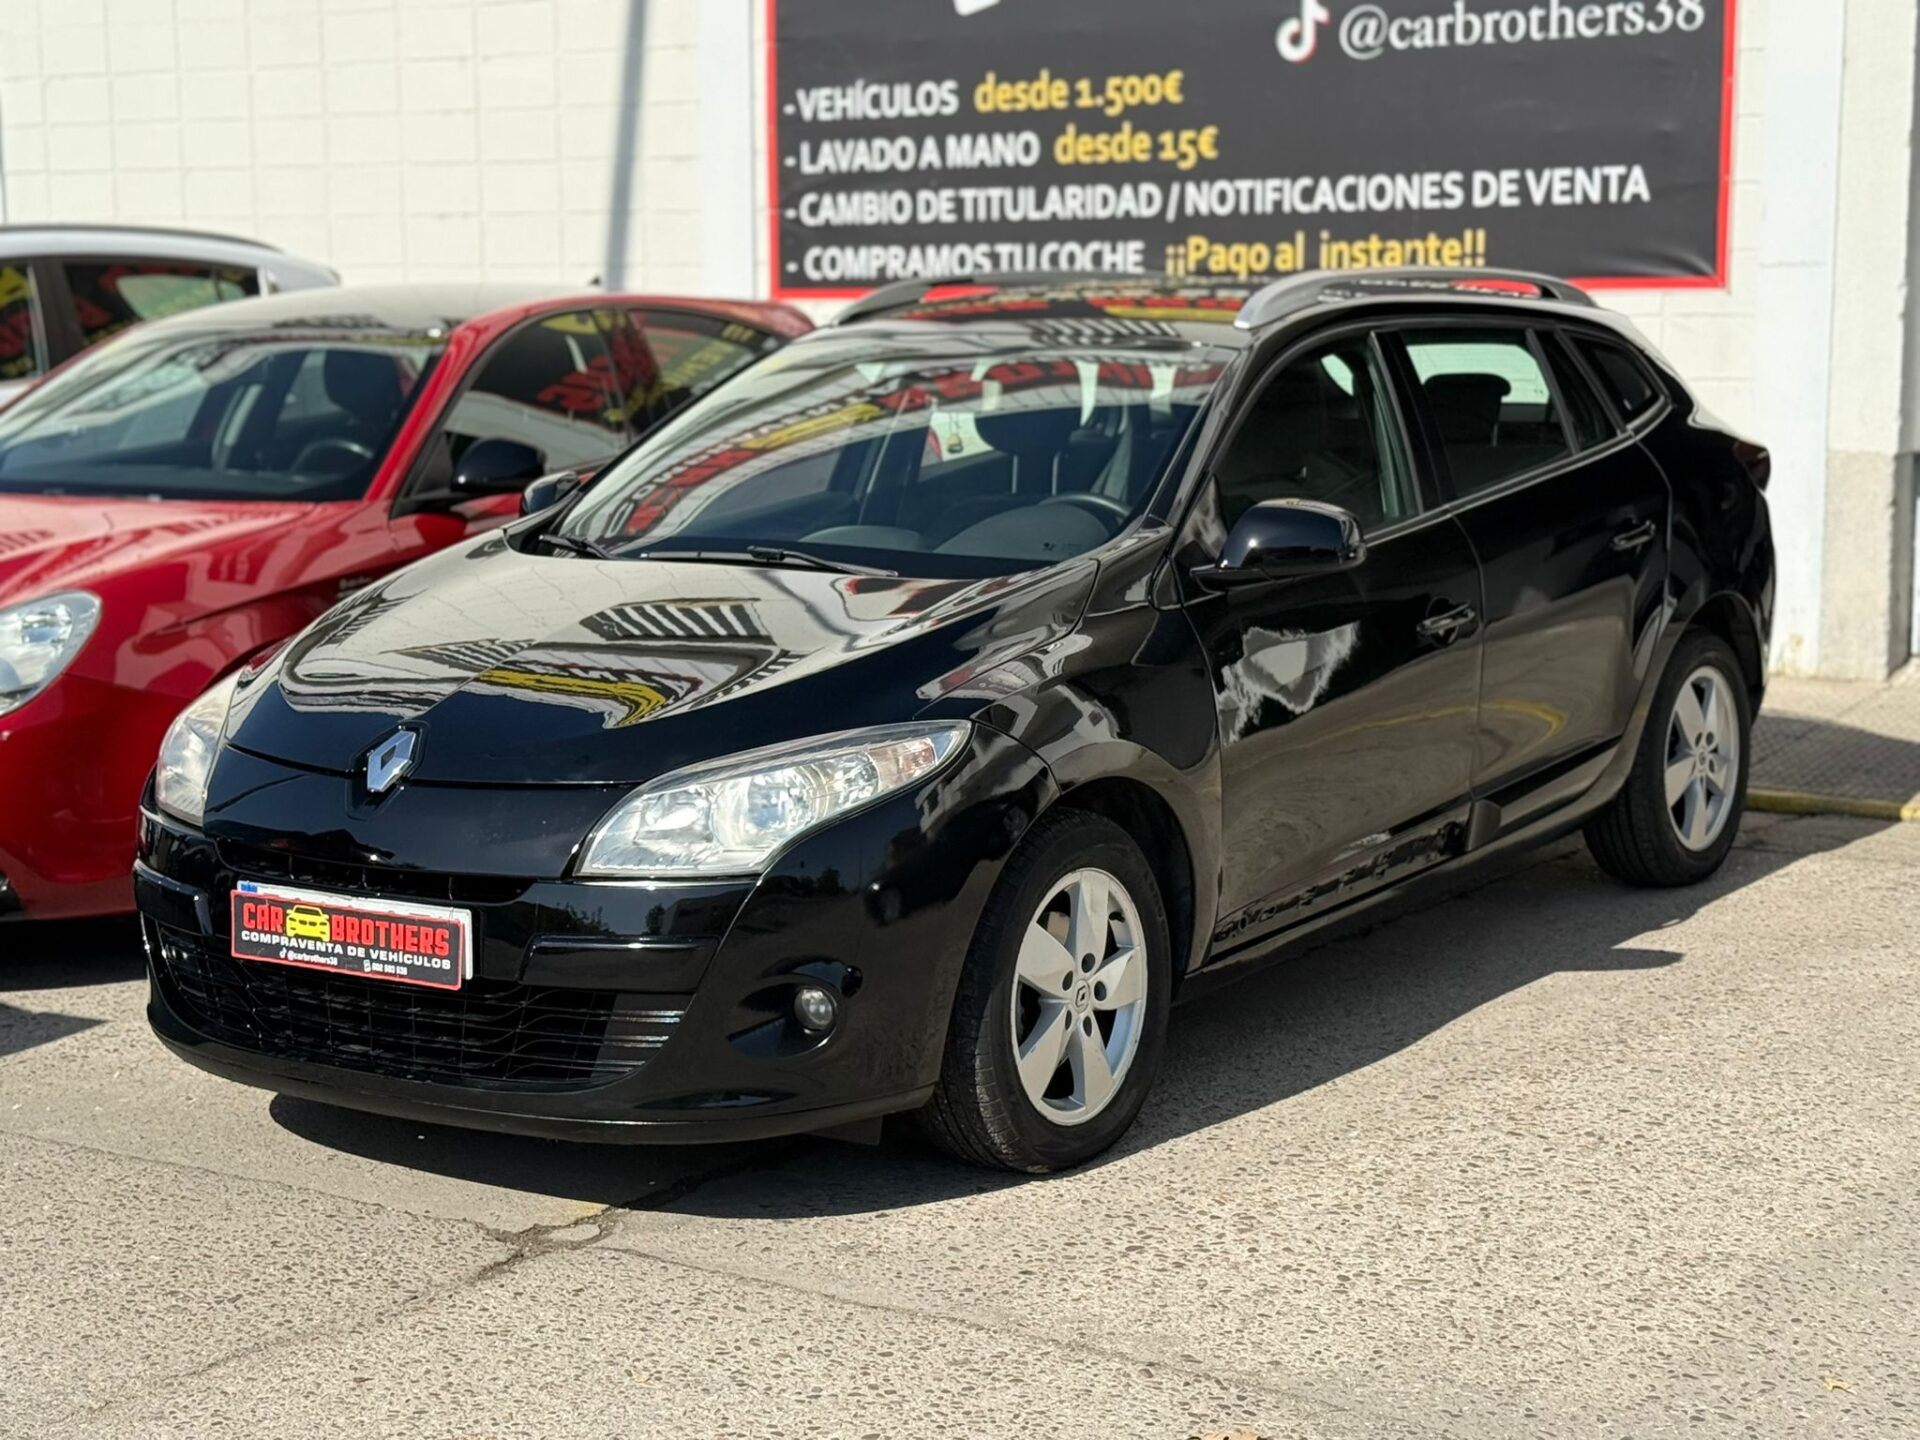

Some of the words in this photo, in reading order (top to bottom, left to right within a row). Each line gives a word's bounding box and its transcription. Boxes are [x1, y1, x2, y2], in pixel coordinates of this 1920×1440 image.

[1338, 0, 1706, 61] @carbrothers38
[796, 79, 959, 122] VEHÍCULOS
[974, 69, 1069, 113] desde
[1075, 70, 1184, 117] 1.500€
[800, 137, 916, 175] LAVADO
[918, 136, 942, 170] A
[945, 132, 1041, 168] MANO
[1054, 122, 1152, 165] desde
[1157, 126, 1219, 170] 15€
[800, 189, 913, 227] CAMBIO
[916, 188, 957, 224] DE
[959, 182, 1162, 222] TITULARIDAD
[1184, 171, 1464, 216] NOTIFICACIONES
[1472, 169, 1521, 209] DE
[1524, 164, 1652, 205] VENTA
[803, 242, 992, 281] COMPRAMOS
[1040, 239, 1146, 275] COCHE
[1274, 229, 1306, 272] al
[1319, 228, 1487, 270] instante!!
[241, 930, 344, 955] COMPRAVENTA
[347, 944, 366, 959] DE
[369, 949, 452, 970] VEHÍCULOS
[242, 902, 284, 933] CAR
[331, 915, 450, 957] BROTHERS
